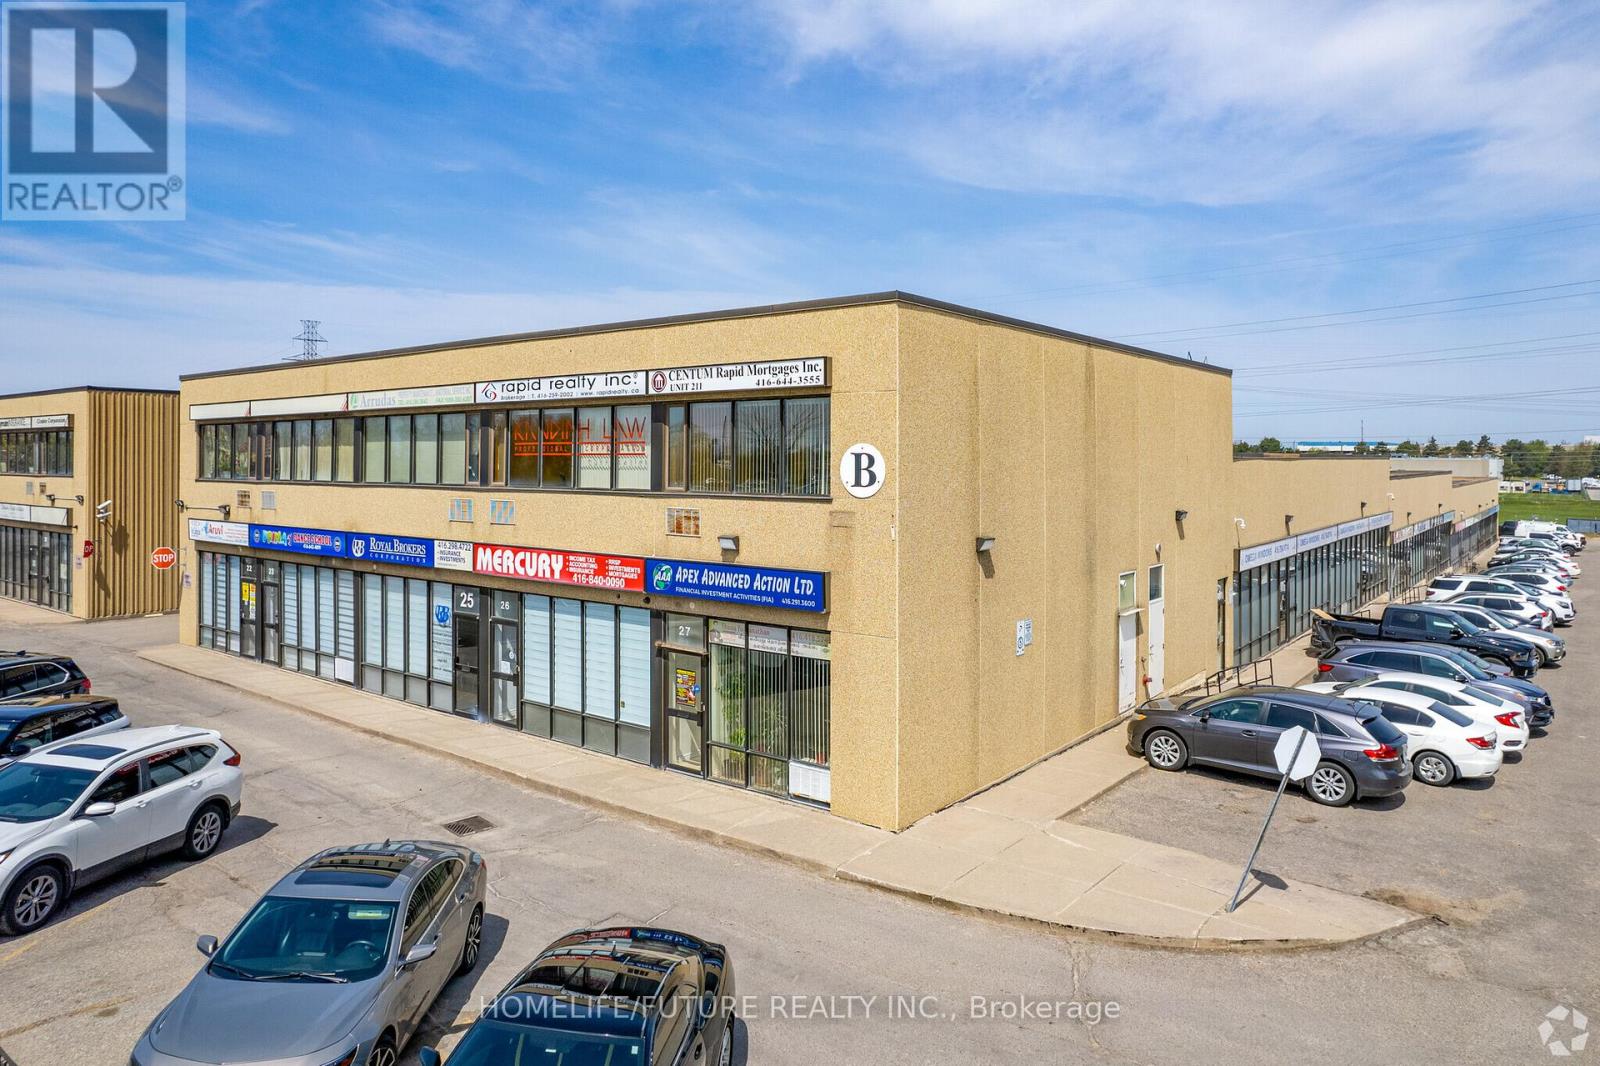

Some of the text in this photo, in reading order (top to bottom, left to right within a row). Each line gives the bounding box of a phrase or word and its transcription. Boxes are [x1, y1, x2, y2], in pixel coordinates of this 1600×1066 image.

[669, 360, 822, 382] CENTUM Rapid Mortgages Inc.
[501, 378, 541, 394] rapid
[549, 375, 596, 391] realty
[670, 382, 703, 392] UNIT 211
[755, 375, 821, 387] 416-644-3555
[850, 452, 877, 488] B
[369, 537, 426, 555] ROYAL BROKERS
[153, 553, 174, 563] STOP
[476, 547, 564, 580] MERCURY
[572, 573, 625, 588] 416-840-0090
[675, 566, 816, 596] APEX ADVANCED ACTION LTD.
[460, 592, 474, 609] 25
[675, 587, 701, 595] FINANCIAL
[701, 590, 733, 598] INVESTMENT
[733, 593, 761, 602] ACTIVITIES
[500, 600, 510, 610] 26
[678, 625, 691, 636] 27
